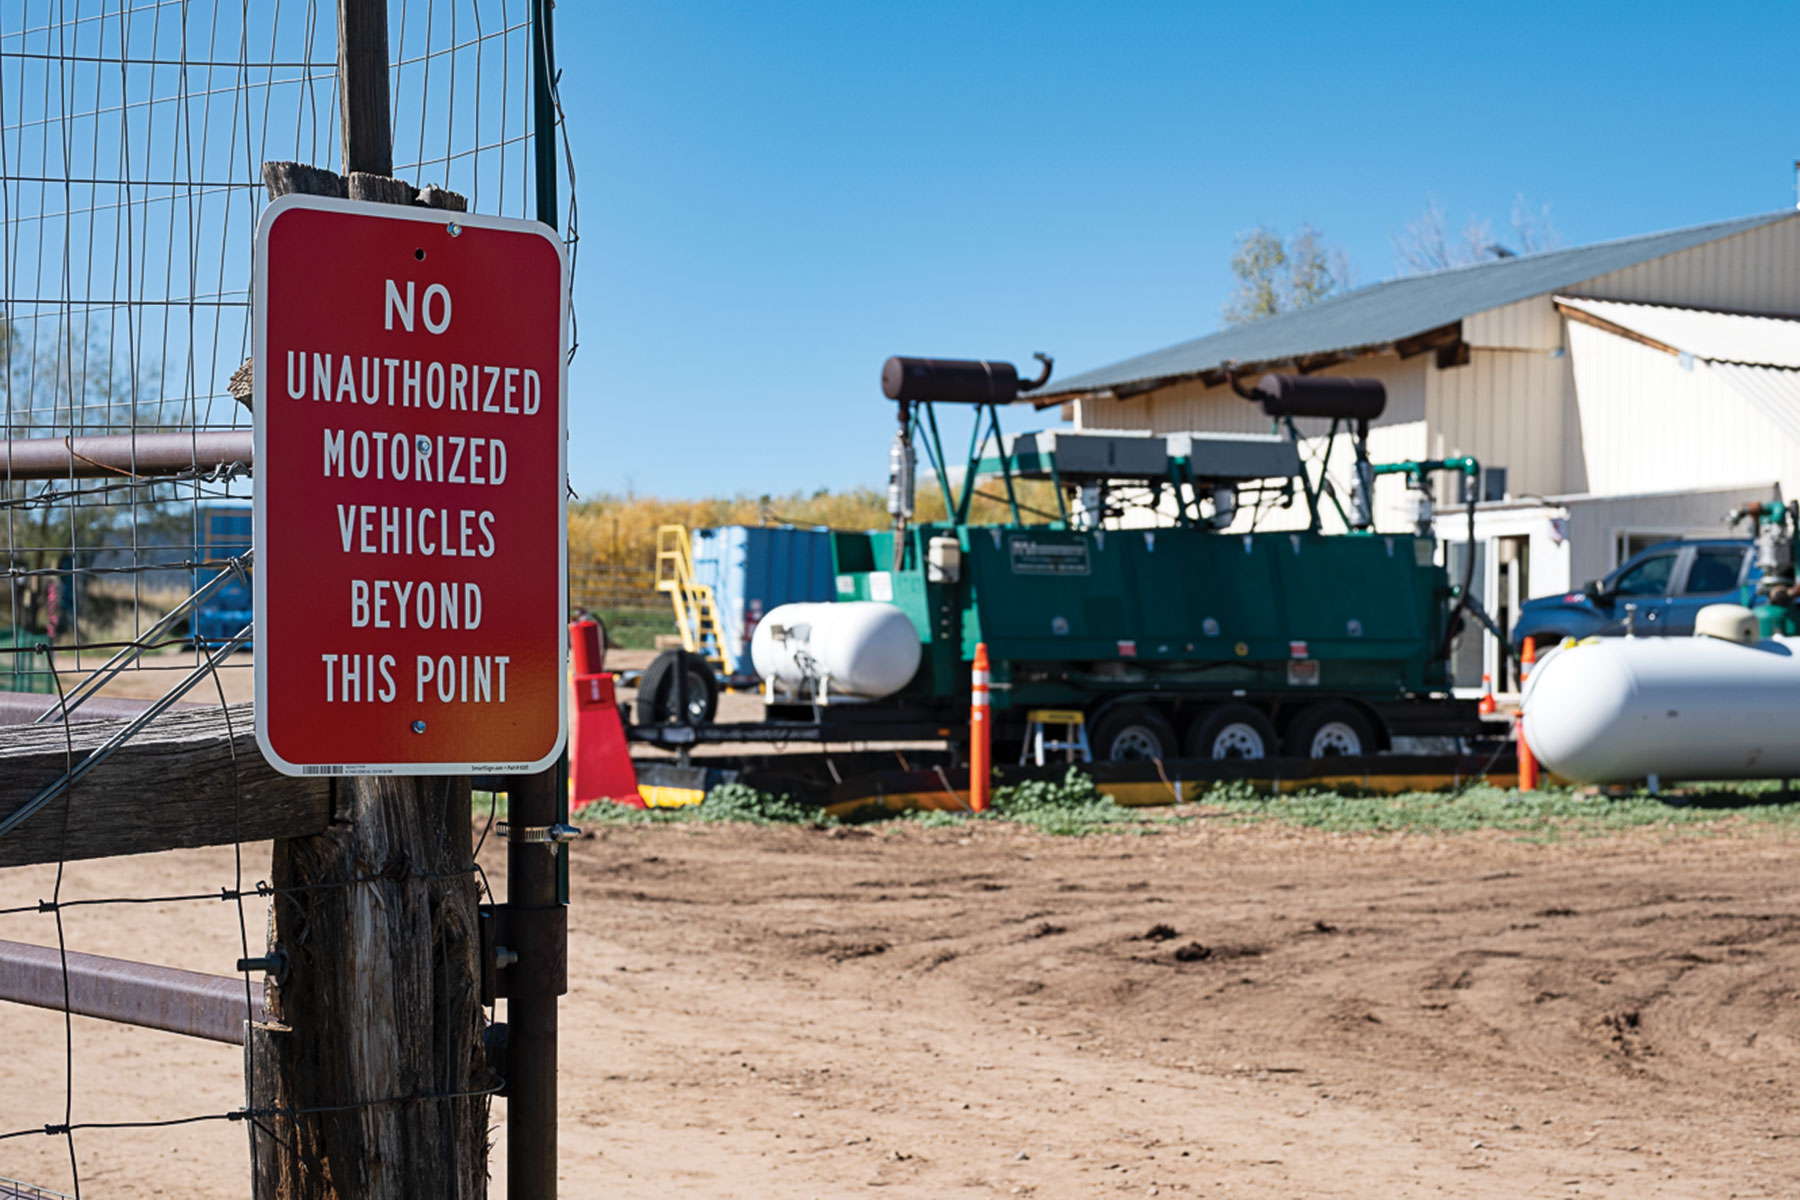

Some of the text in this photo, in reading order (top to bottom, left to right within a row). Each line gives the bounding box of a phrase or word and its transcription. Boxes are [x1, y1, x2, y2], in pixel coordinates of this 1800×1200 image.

[384, 279, 452, 335] NO
[287, 350, 541, 415] UNAUTHORIZED
[323, 428, 507, 485] MOTORIZED
[337, 504, 495, 558] VEHICLES
[351, 579, 482, 630] BEYOND
[322, 653, 510, 703] THIS POINT
